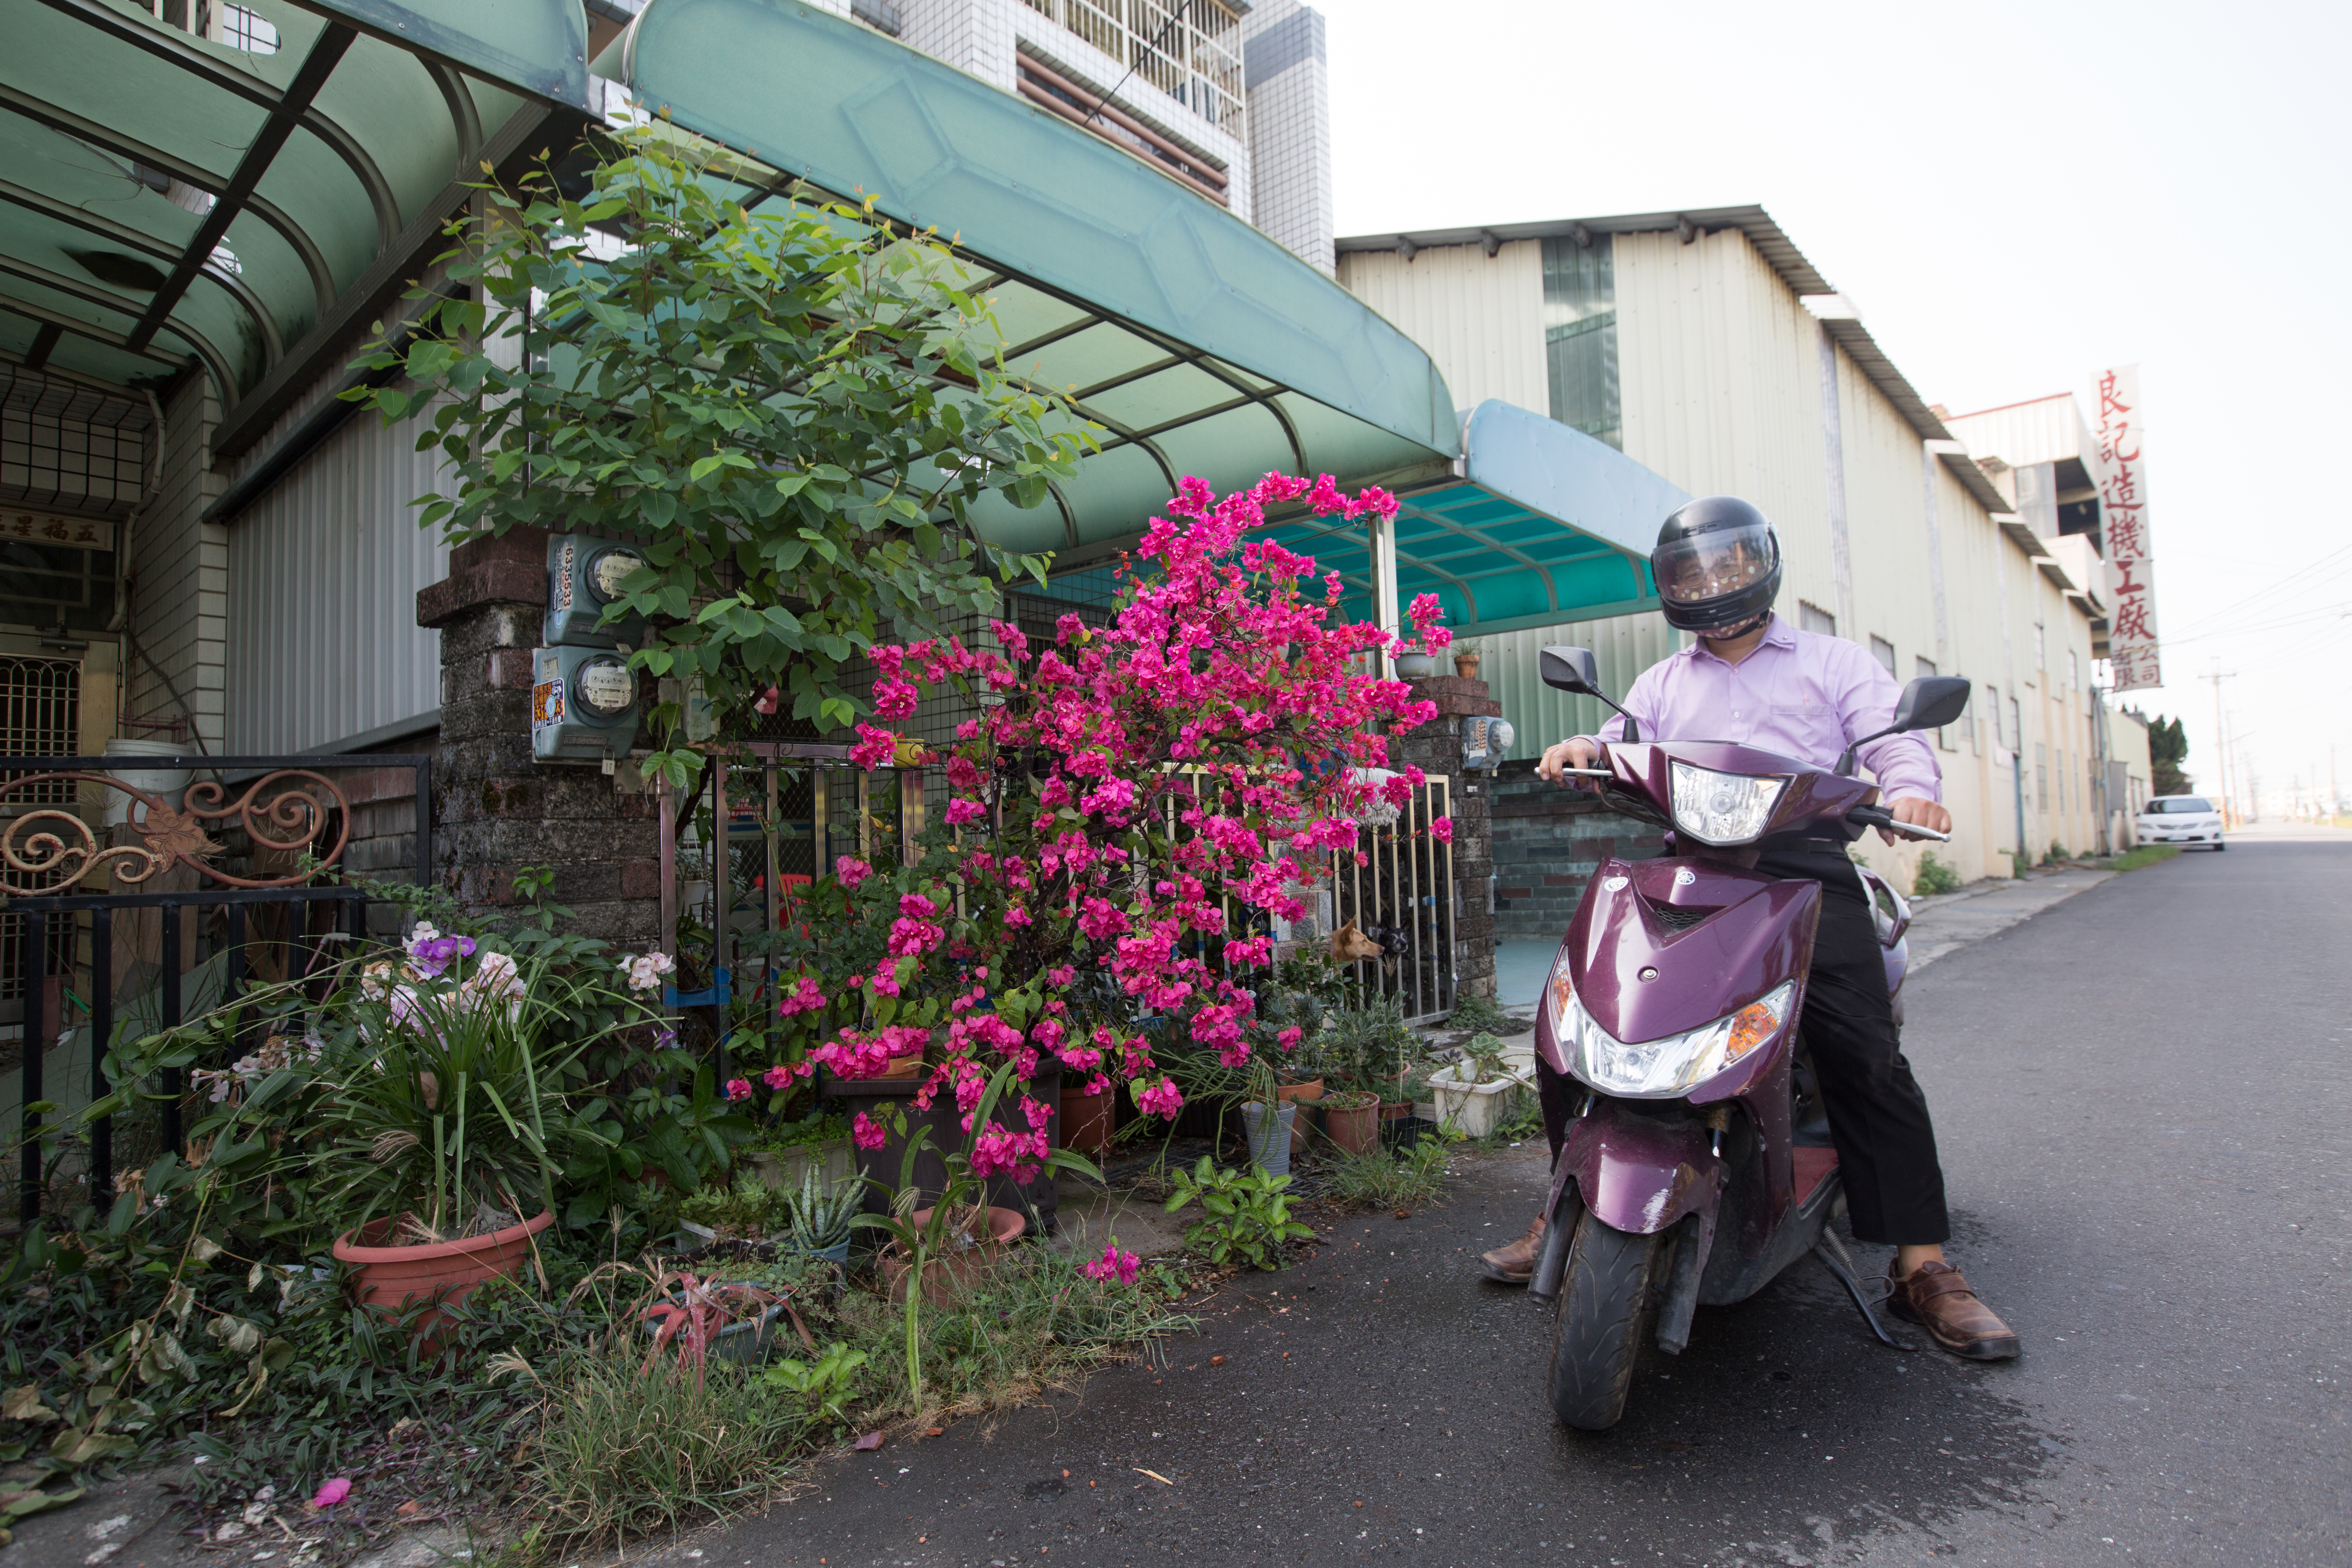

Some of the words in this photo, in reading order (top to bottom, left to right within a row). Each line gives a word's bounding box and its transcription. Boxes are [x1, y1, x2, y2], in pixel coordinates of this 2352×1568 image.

[564, 548, 573, 607] 6335533
[2097, 370, 2156, 640] 良記造機工廠
